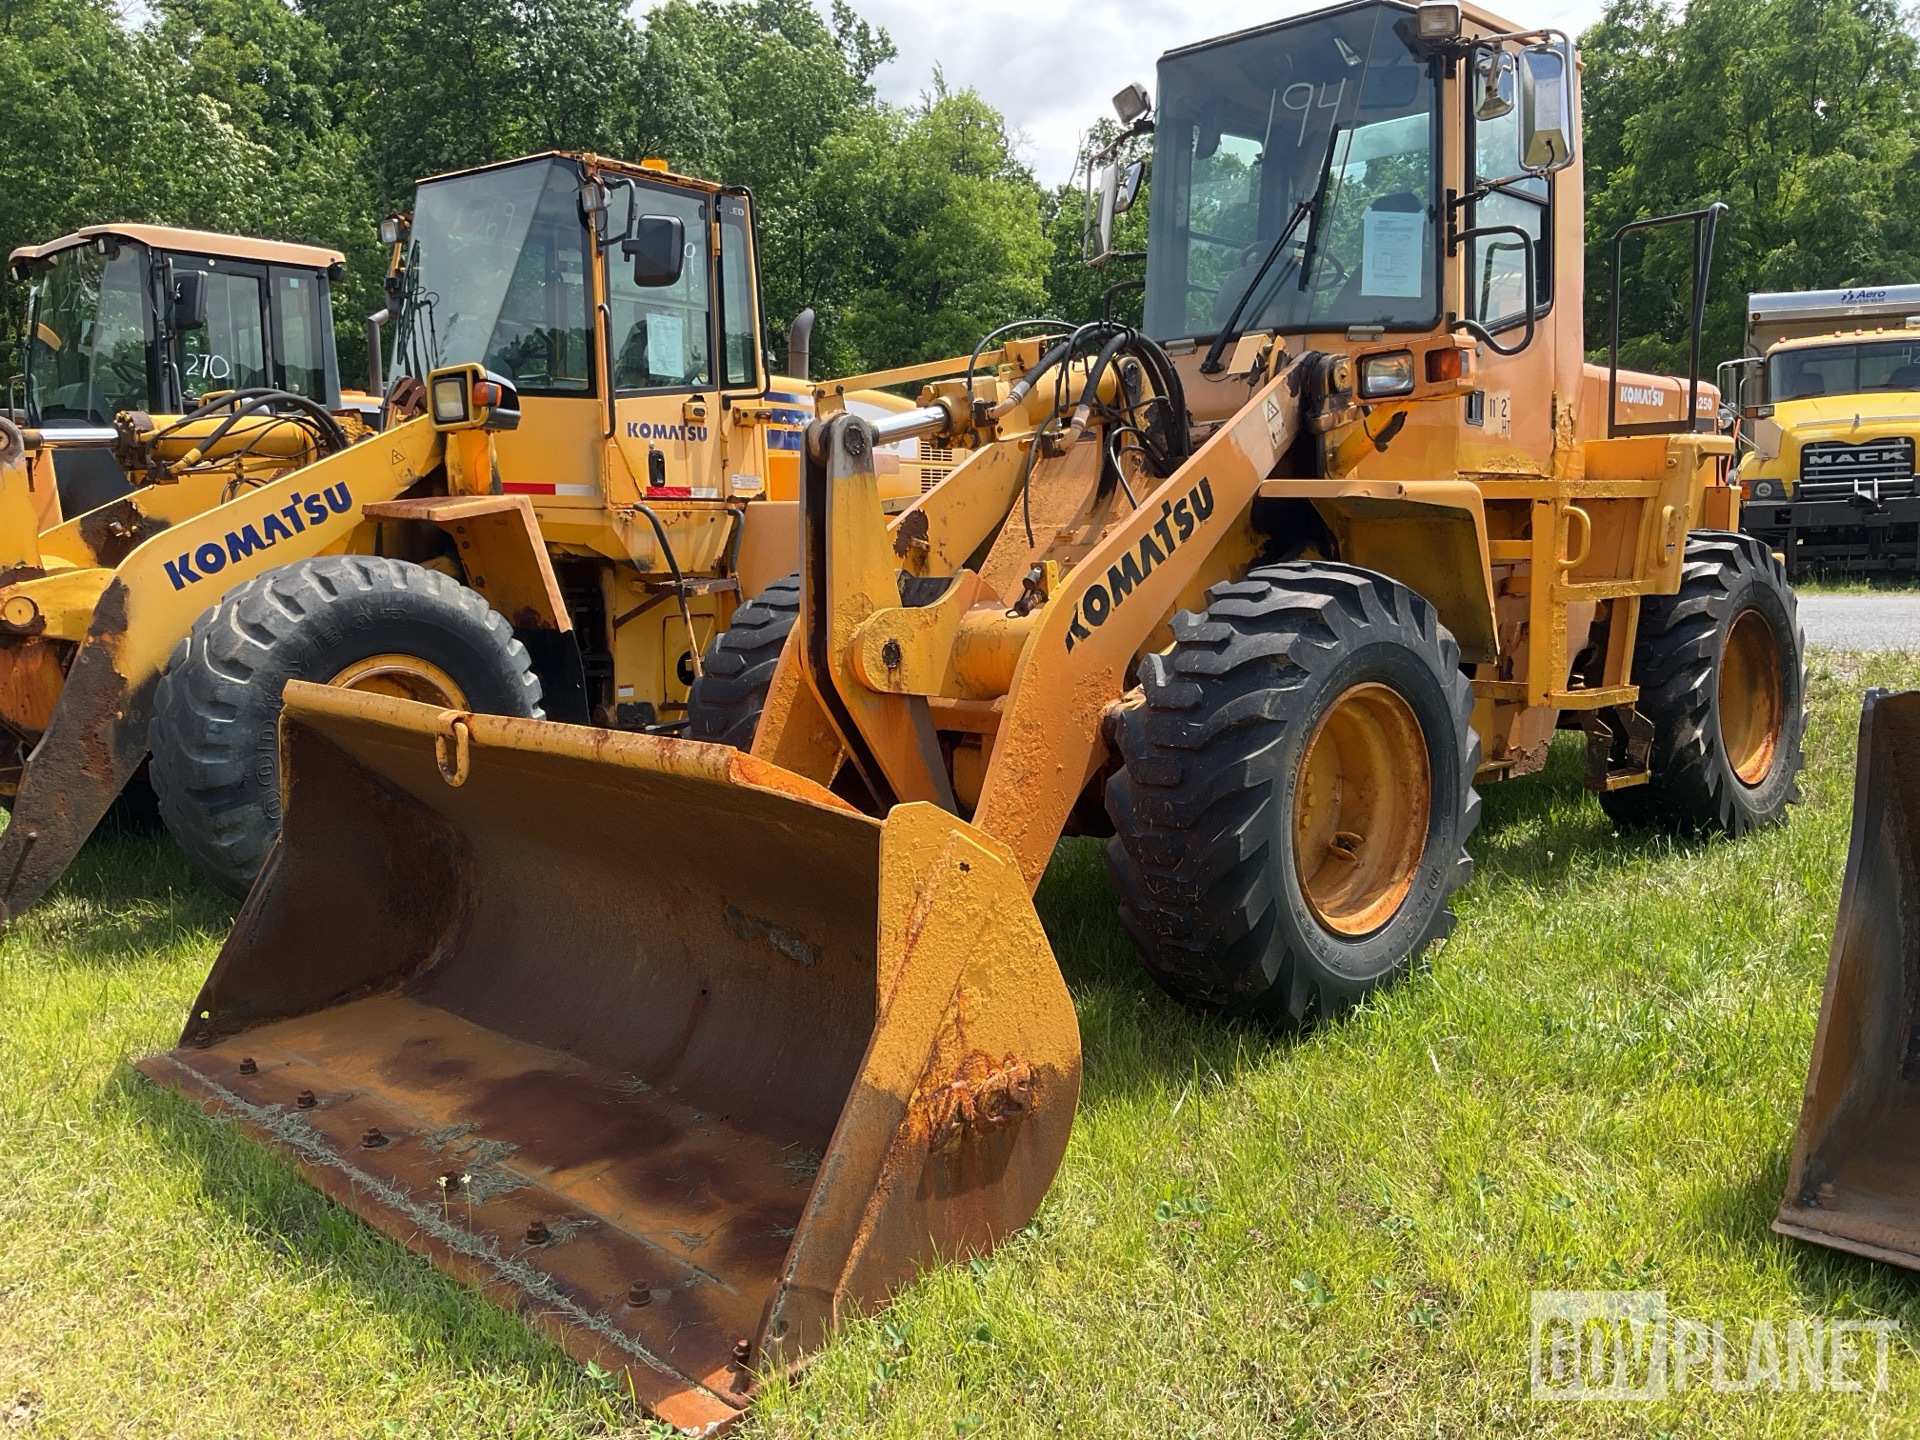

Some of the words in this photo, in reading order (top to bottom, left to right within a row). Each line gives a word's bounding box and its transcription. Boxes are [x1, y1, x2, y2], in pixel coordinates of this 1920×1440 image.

[1261, 77, 1347, 164] 194
[1856, 289, 1886, 299] Aero
[185, 353, 231, 379] 270
[1620, 385, 1664, 407] KOMATSU
[627, 422, 708, 442] KOMATSU
[1809, 450, 1905, 465] MACK
[163, 481, 353, 591] KOMATSU
[1065, 476, 1214, 655] KOMATSU
